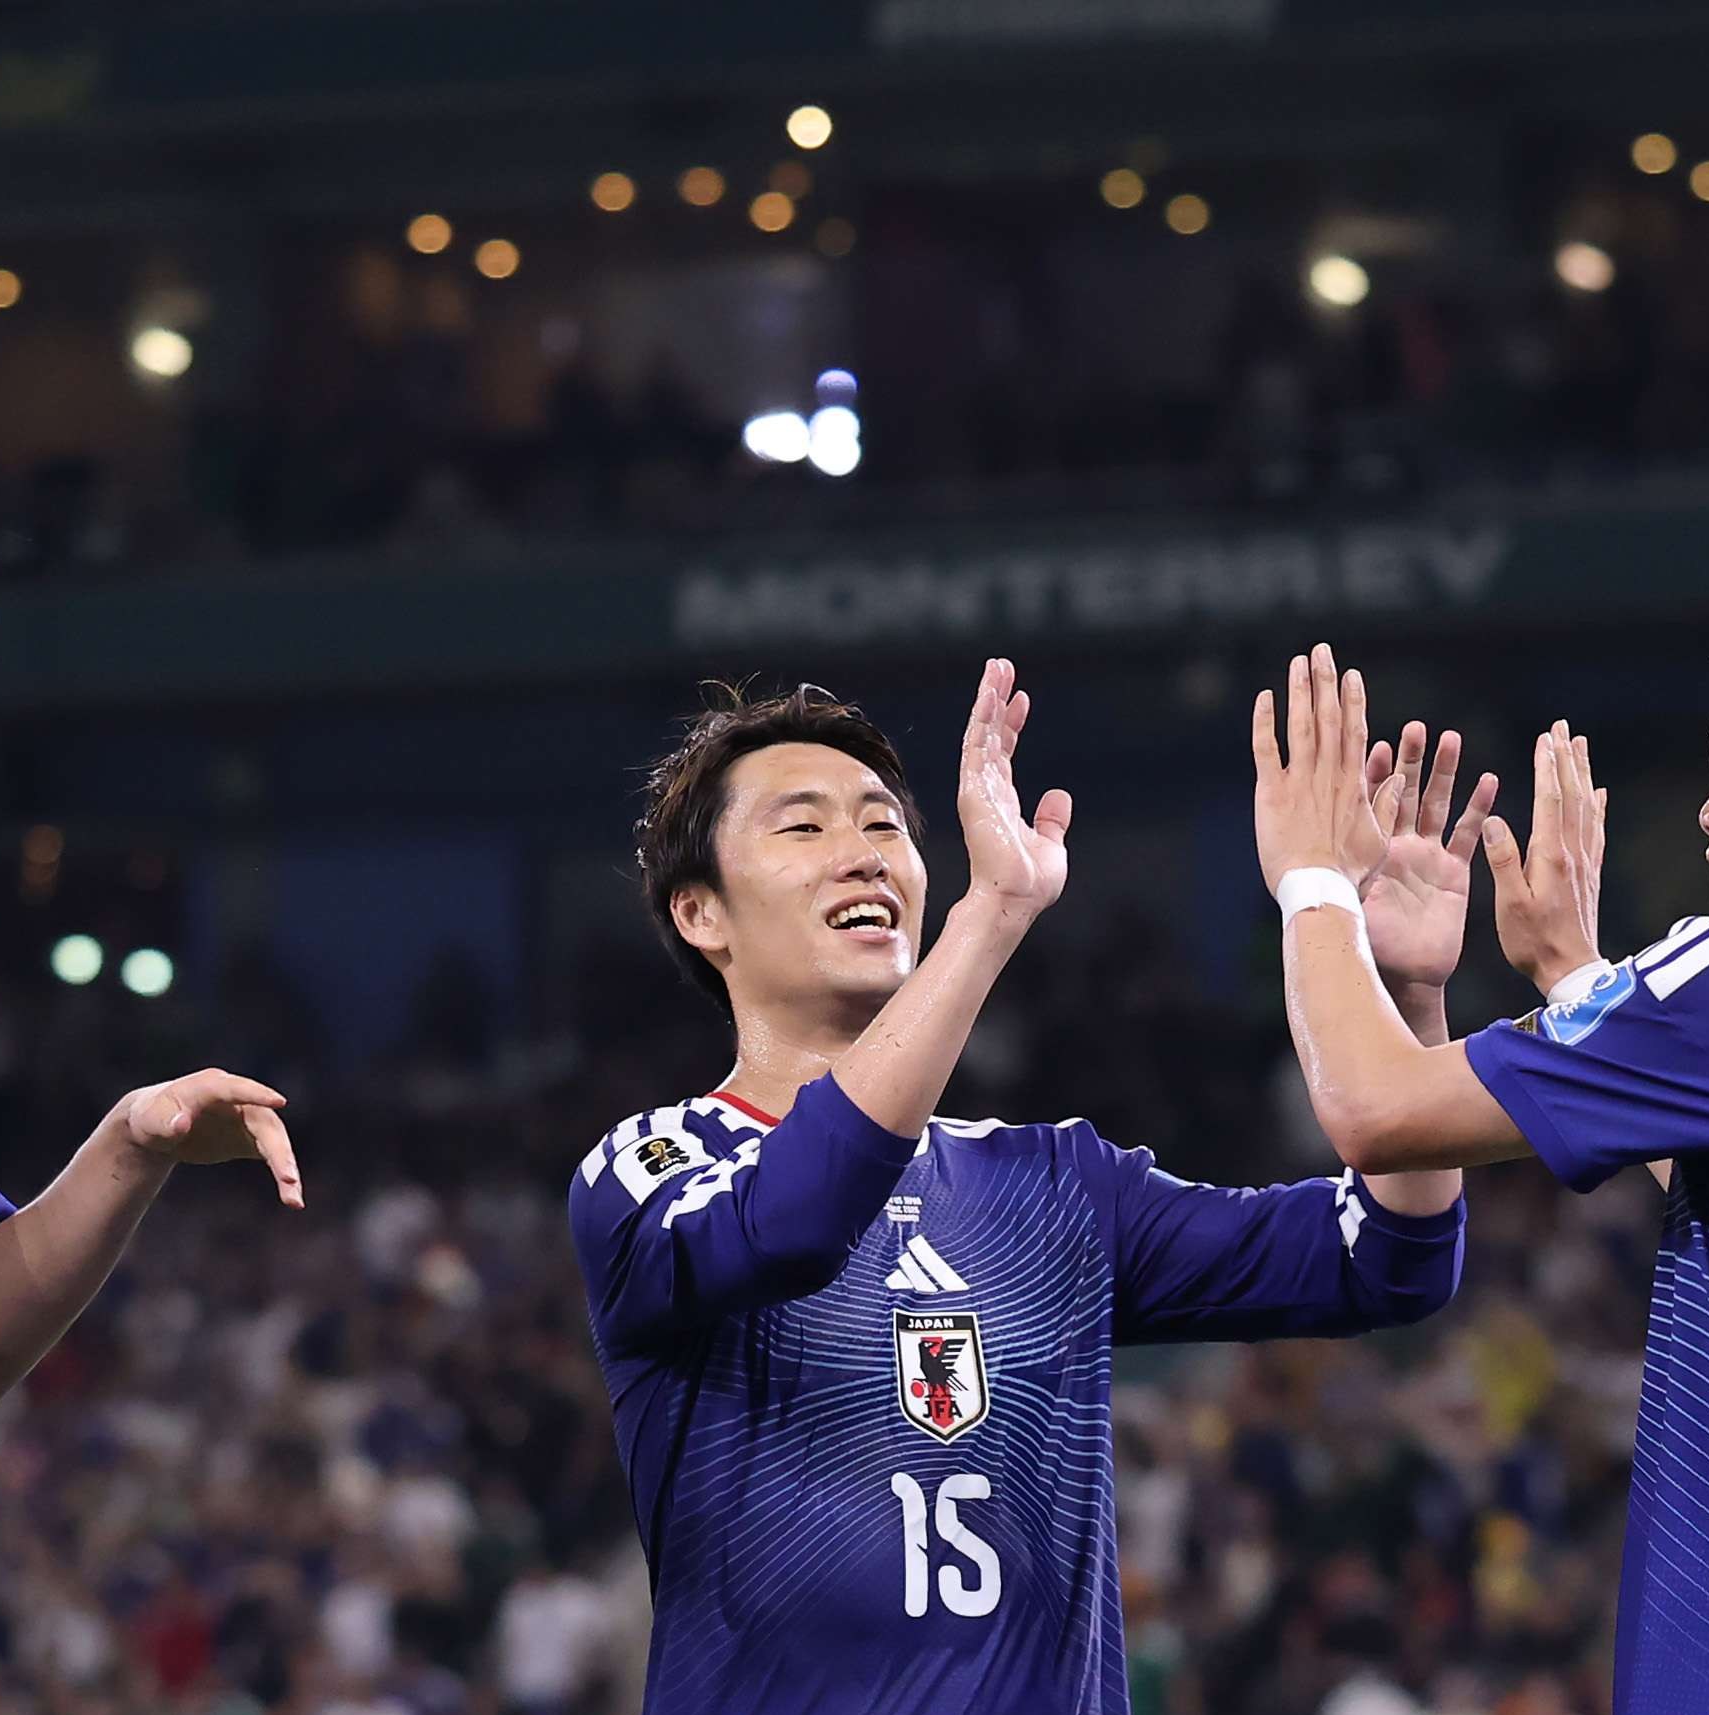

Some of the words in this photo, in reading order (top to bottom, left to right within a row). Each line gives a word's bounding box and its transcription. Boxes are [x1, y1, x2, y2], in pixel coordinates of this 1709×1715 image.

[907, 1317, 955, 1330] JAPAN
[922, 1399, 964, 1420] JFA
[891, 1471, 1002, 1618] 15
